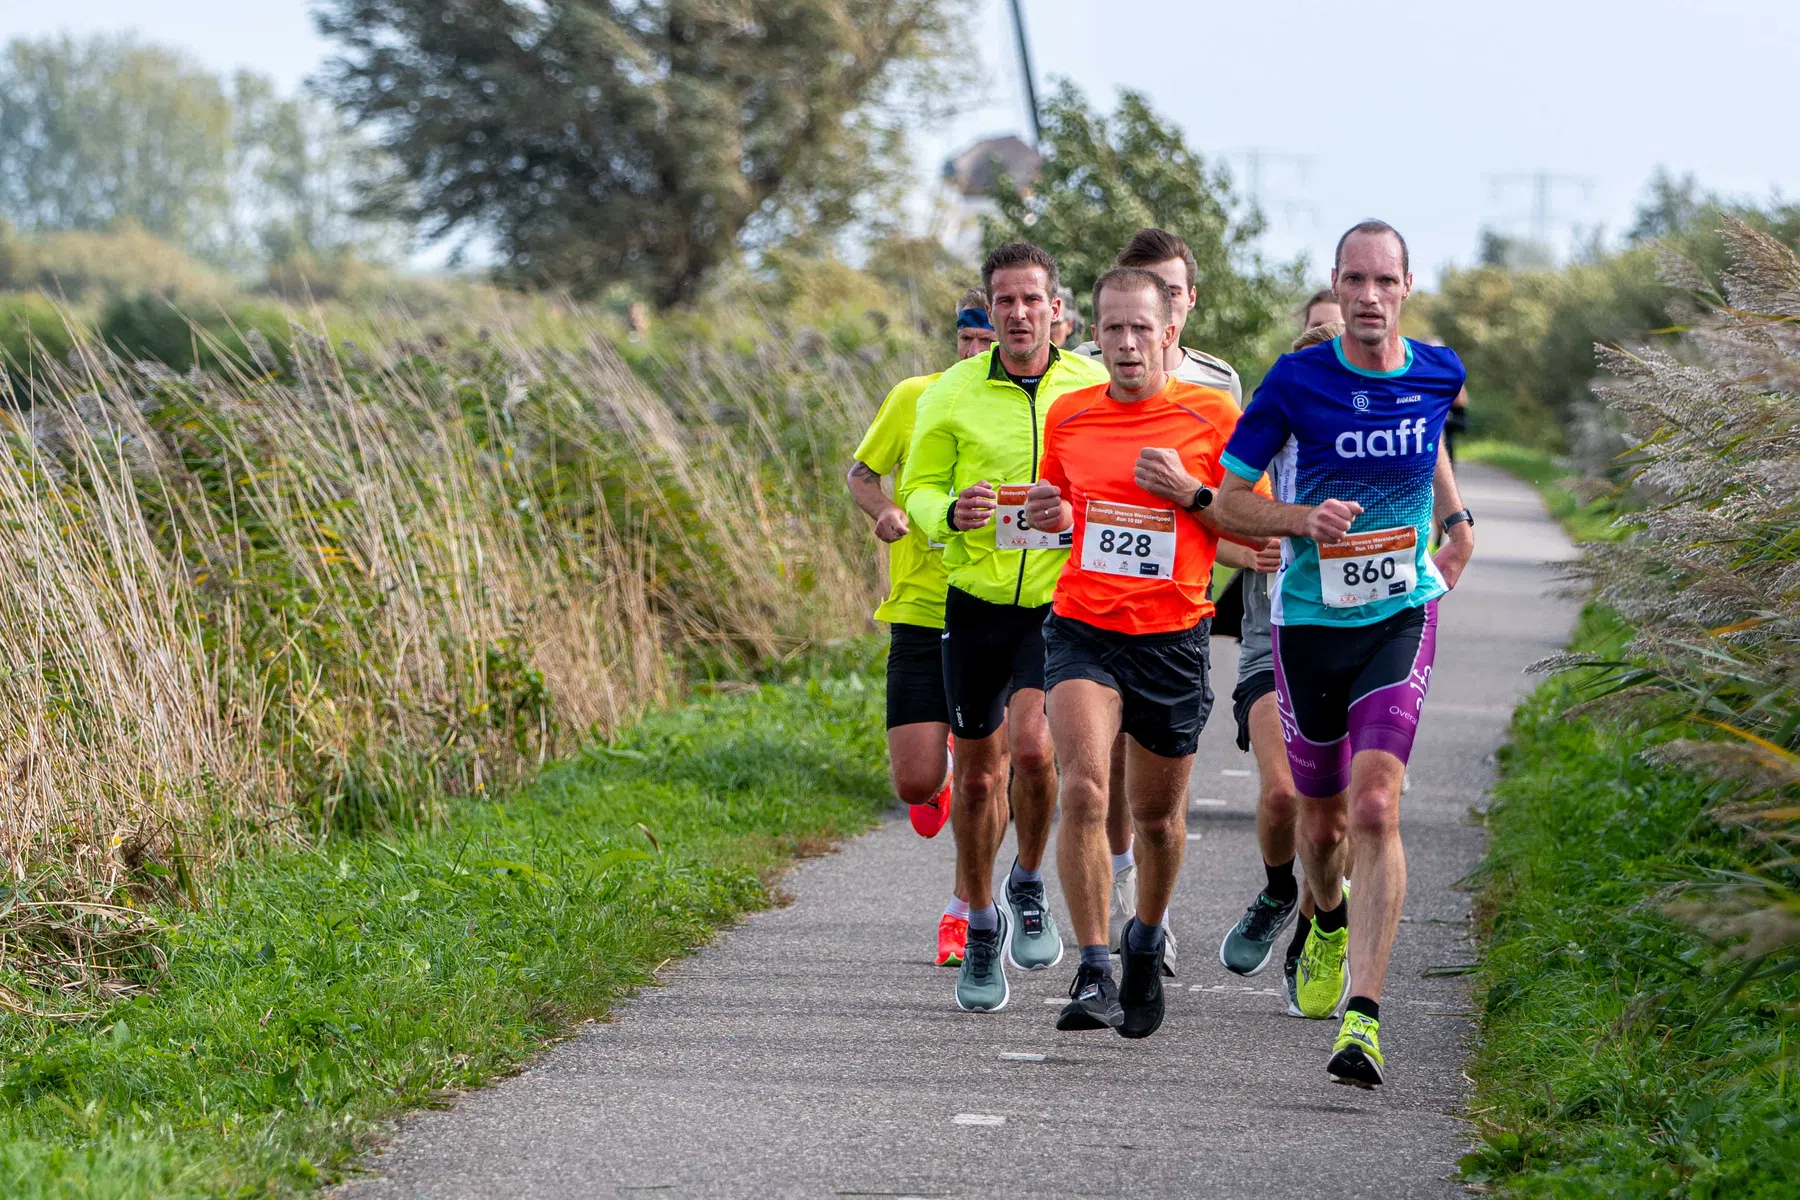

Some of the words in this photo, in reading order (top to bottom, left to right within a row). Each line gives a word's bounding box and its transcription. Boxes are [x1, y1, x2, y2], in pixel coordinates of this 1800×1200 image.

[1114, 510, 1133, 518] Unesco
[1100, 529, 1151, 558] 828
[1355, 544, 1366, 552] Run
[1367, 543, 1374, 551] 10
[1342, 556, 1395, 587] 860
